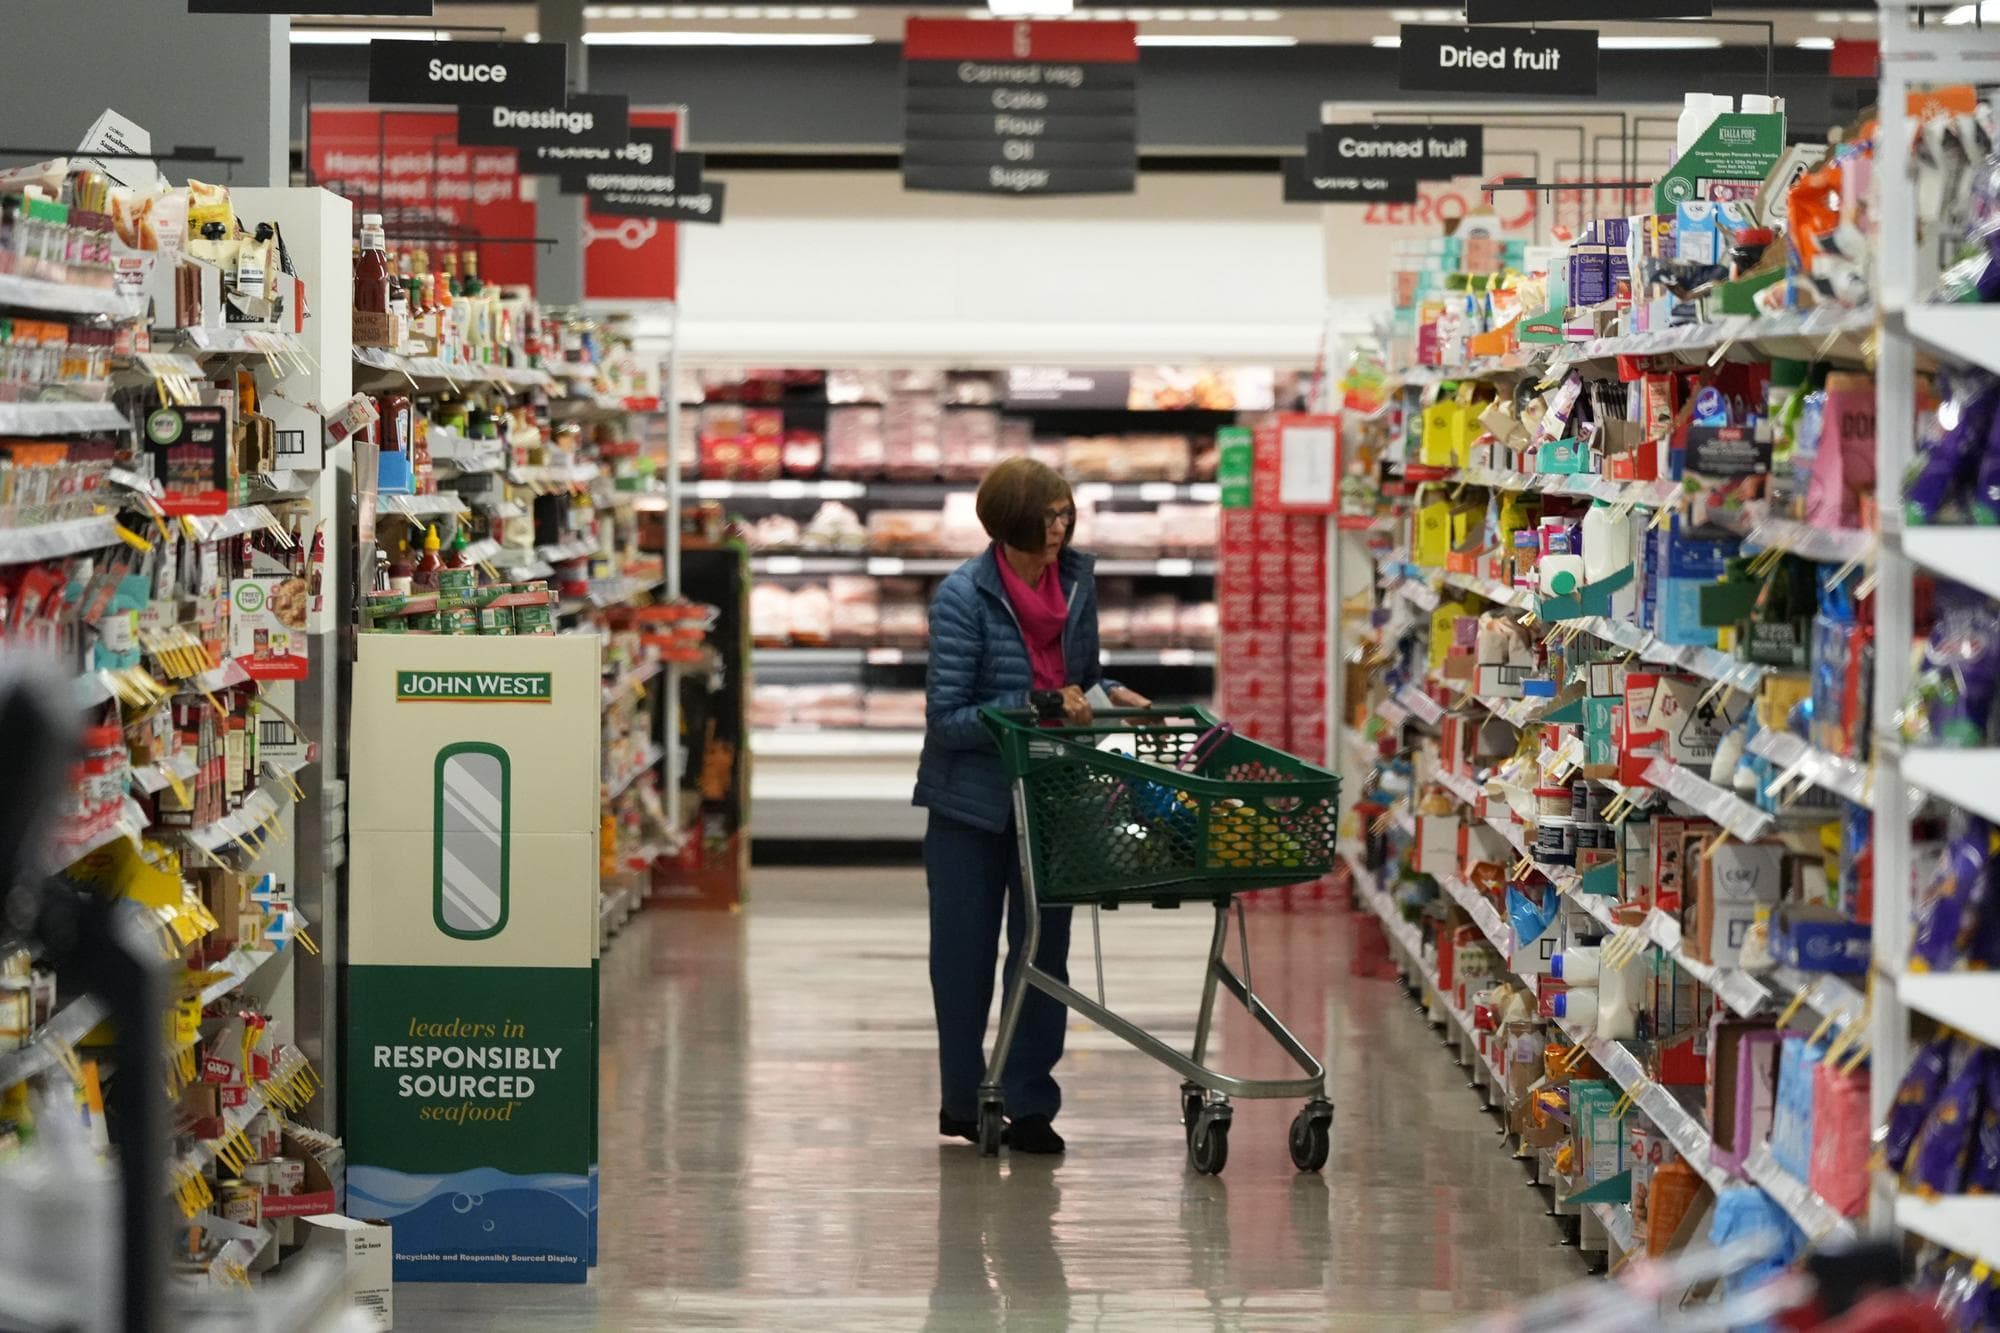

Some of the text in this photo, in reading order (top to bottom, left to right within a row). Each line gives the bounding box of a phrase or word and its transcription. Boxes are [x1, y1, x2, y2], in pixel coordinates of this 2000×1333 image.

[1439, 45, 1561, 70] Dried fruit
[428, 58, 508, 83] Sauce
[958, 61, 1084, 88] Canned veg
[991, 88, 1049, 109] Cake
[492, 106, 594, 134] Dressings
[994, 114, 1045, 135] Flour
[1338, 137, 1468, 158] Canned fruit
[988, 165, 1050, 191] Sugar
[1581, 255, 1605, 265] Cadbury
[403, 674, 544, 695] JOHN WEST
[408, 1017, 526, 1039] leaders in
[207, 1061, 230, 1075] OXO
[374, 1045, 563, 1070] RESPONSIBLY
[398, 1074, 536, 1099] SOURCED
[395, 1254, 440, 1262] Recyclable
[460, 1254, 509, 1263] Responsibly
[511, 1254, 546, 1262] Sourced
[547, 1255, 578, 1264] Display
